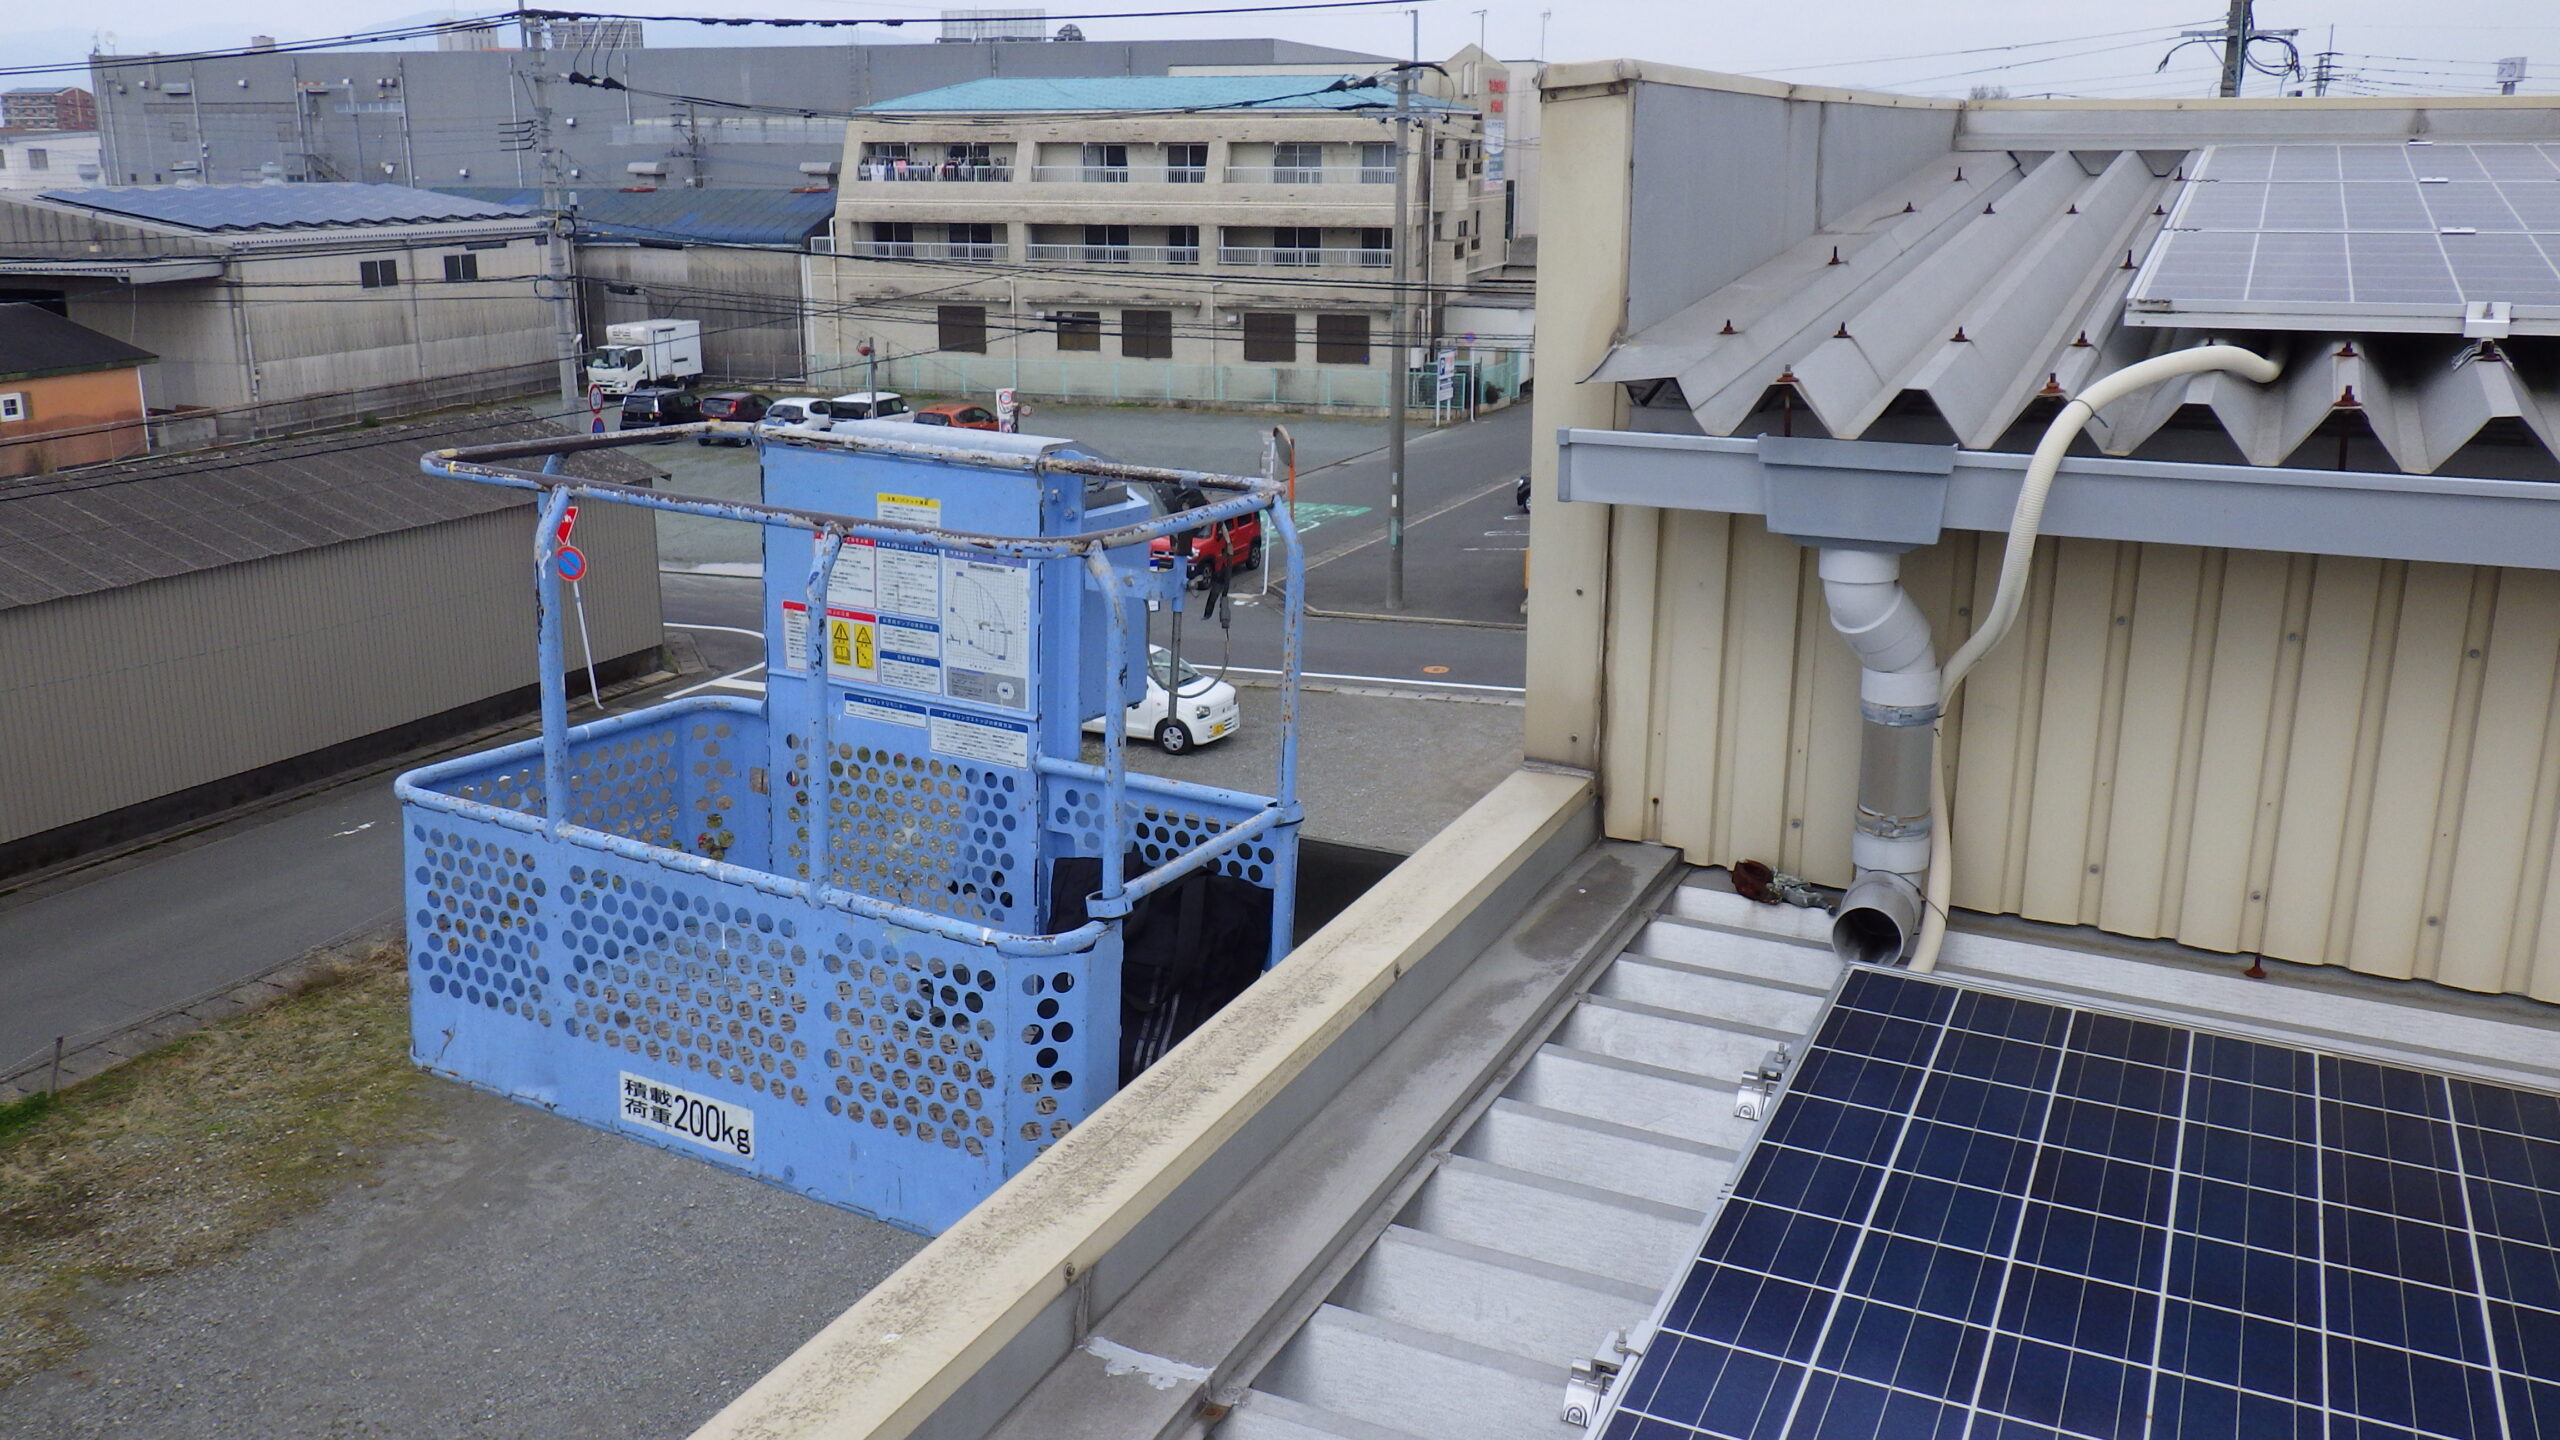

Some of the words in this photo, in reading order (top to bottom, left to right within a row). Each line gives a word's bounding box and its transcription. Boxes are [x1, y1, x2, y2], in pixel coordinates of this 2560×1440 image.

[624, 1079, 673, 1108] 積載
[624, 1097, 672, 1128] 荷重
[674, 1095, 751, 1155] 200kg
